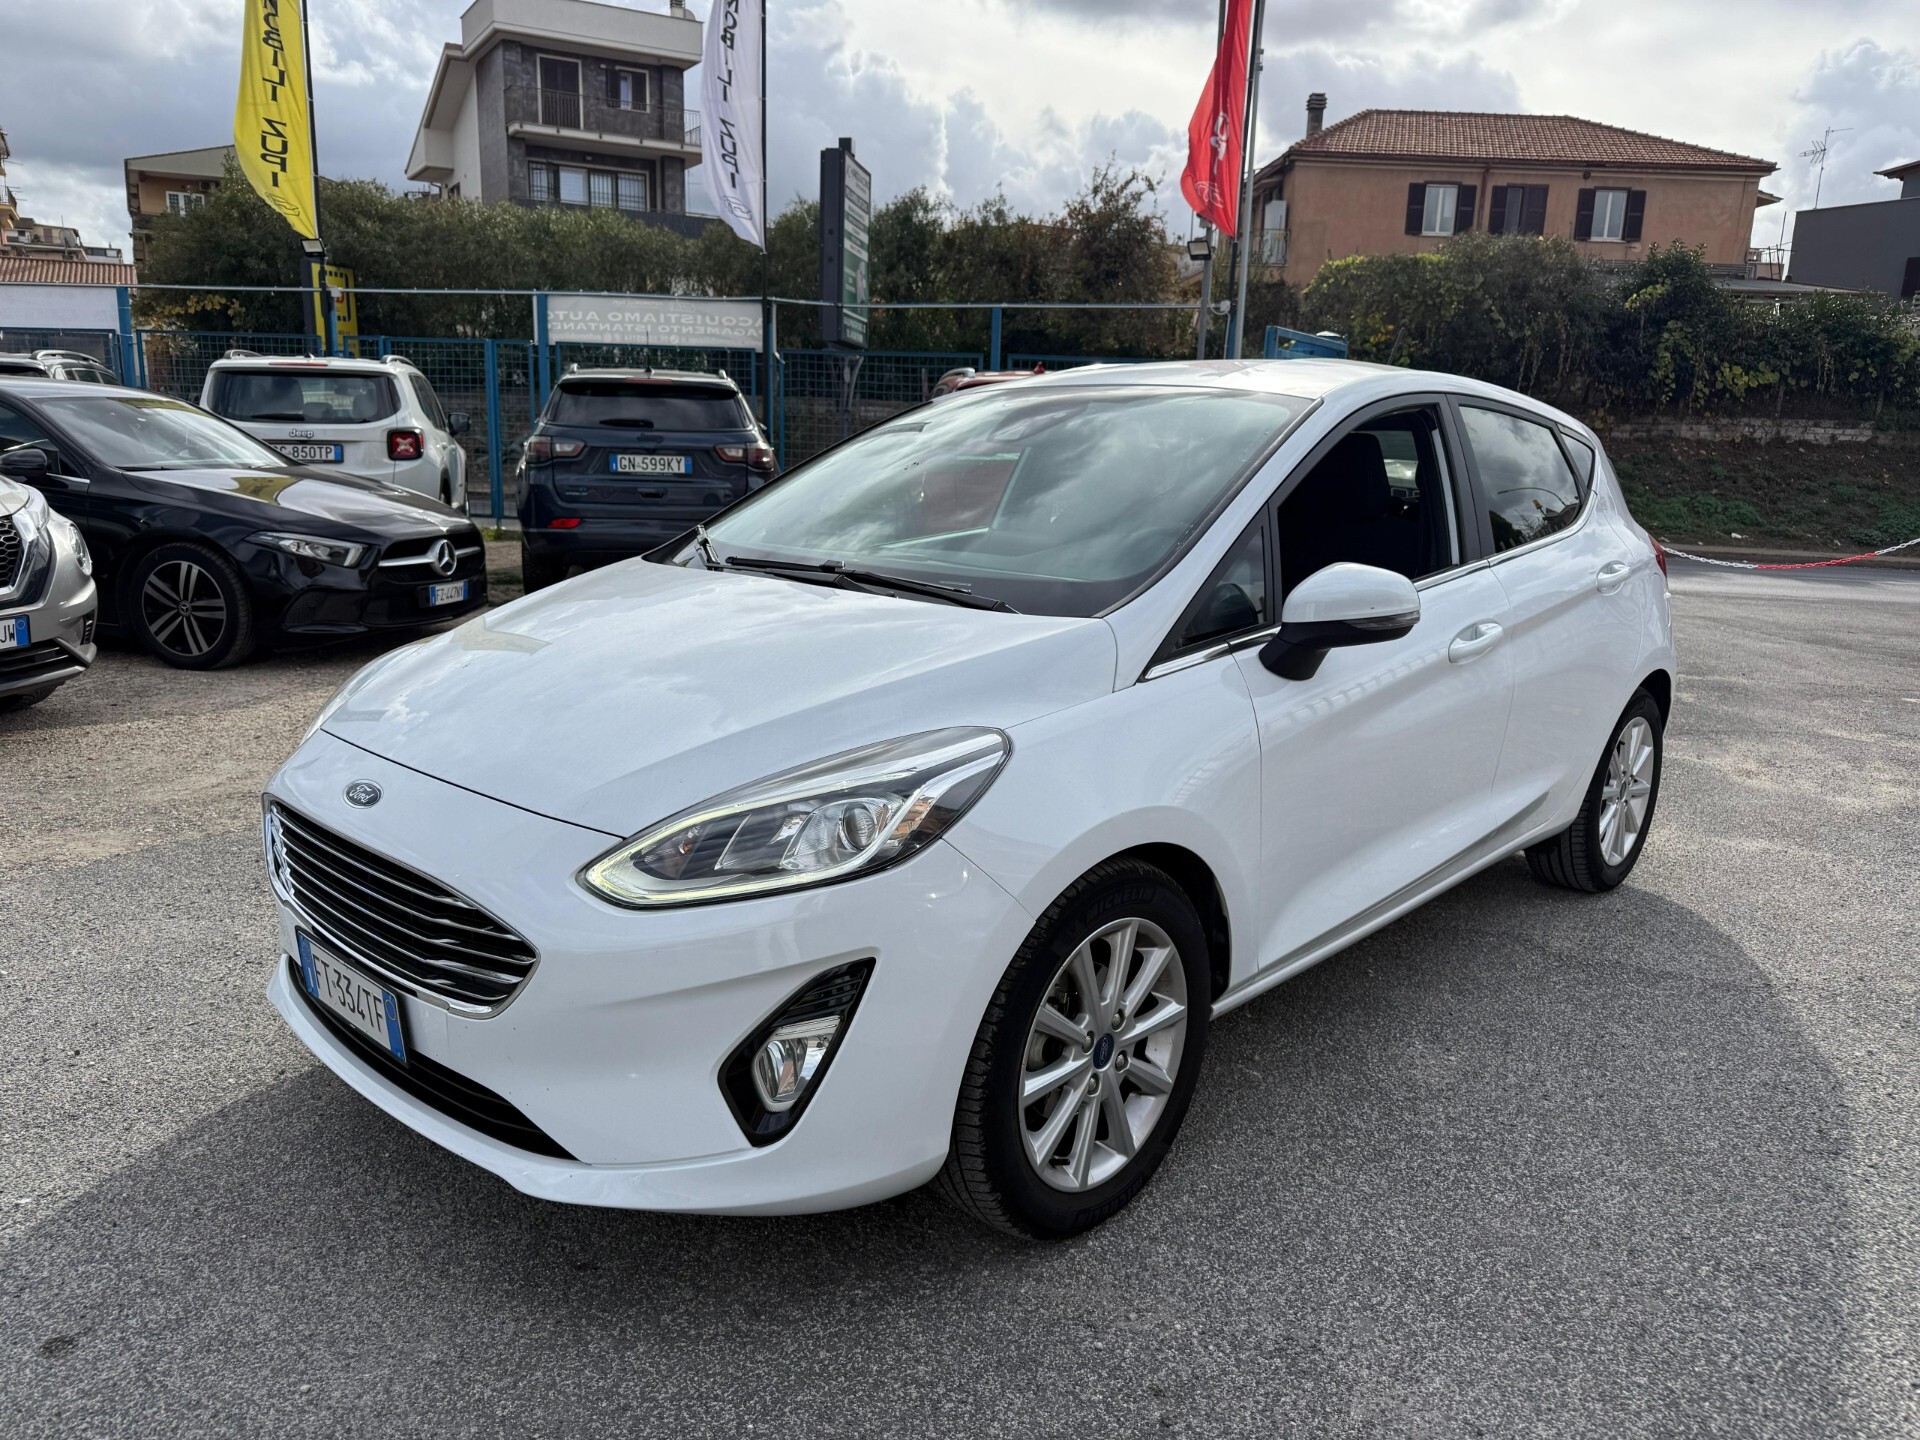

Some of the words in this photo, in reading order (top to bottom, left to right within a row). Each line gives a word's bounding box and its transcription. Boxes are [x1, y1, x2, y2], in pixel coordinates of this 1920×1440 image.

[289, 428, 315, 440] Jeep
[292, 446, 332, 459] 850TP
[349, 784, 375, 803] Ford
[333, 967, 383, 1033] 334TF
